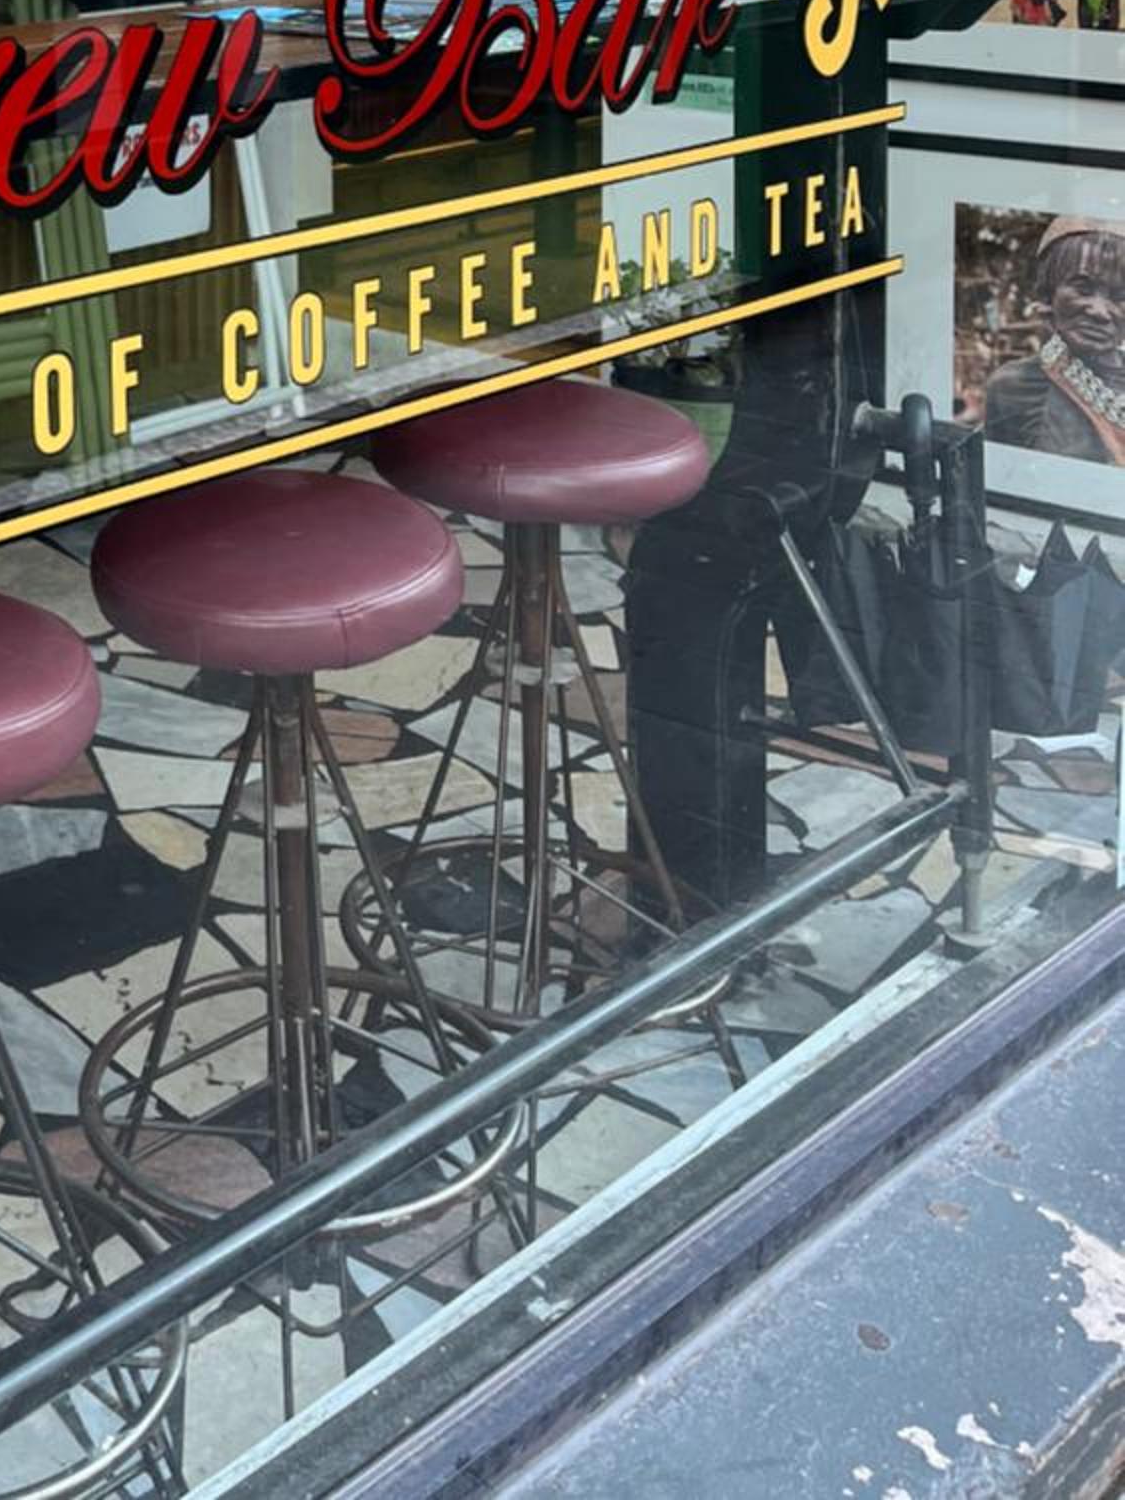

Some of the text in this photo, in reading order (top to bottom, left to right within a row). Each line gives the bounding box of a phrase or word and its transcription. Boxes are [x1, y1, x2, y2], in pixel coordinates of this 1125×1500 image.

[32, 334, 143, 455] OF
[221, 241, 538, 404] COFFEE
[592, 199, 717, 304] AND
[764, 166, 865, 258] TEA
